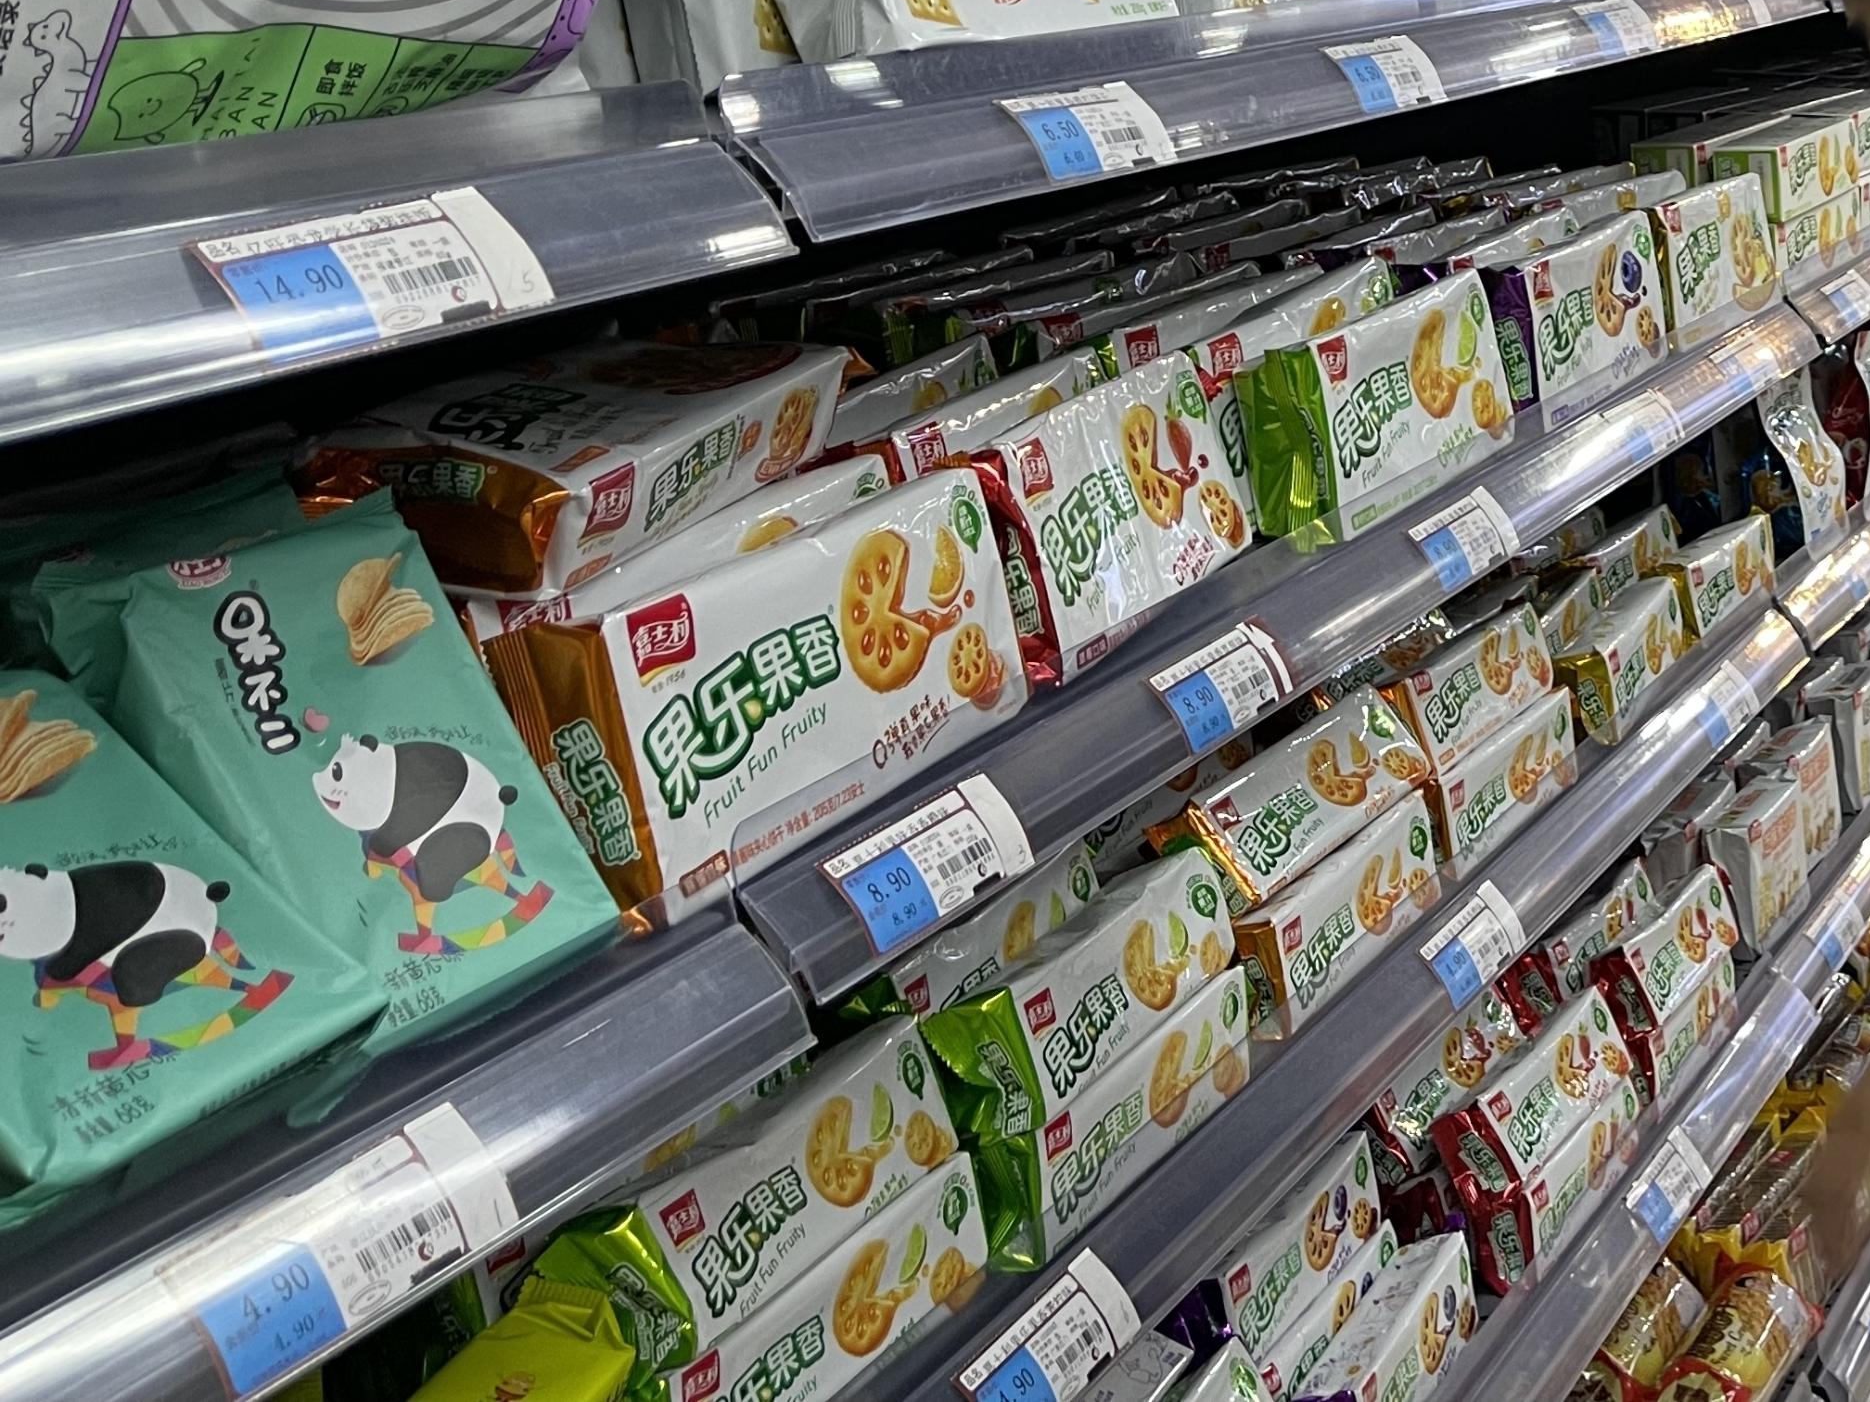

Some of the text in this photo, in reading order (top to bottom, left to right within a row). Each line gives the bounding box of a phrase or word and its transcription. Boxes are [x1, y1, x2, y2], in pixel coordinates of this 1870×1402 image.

[316, 59, 346, 96] 即食
[337, 60, 368, 97] 拌饭
[1042, 119, 1079, 141] 6.50
[254, 263, 345, 305] 14.90
[1539, 286, 1596, 381] 果乐果香
[1331, 361, 1412, 479] 果乐果香
[645, 419, 738, 533] 果乐果香
[1039, 465, 1140, 608] 果乐果香
[630, 610, 692, 664] 嘉士利
[644, 613, 842, 820] 果乐果香
[1182, 687, 1213, 715] 8.90
[1424, 660, 1481, 743] 果乐果香
[550, 718, 642, 868] 果乐果香
[703, 702, 827, 829] Fruit Fun Fruity
[1236, 782, 1319, 876] 果乐果香
[1454, 773, 1507, 857] 果乐果香
[867, 867, 912, 904] 8.90
[892, 902, 918, 927] 8.90
[383, 949, 466, 993] 新黄瓜味
[1289, 902, 1355, 1010] 果乐果香
[1043, 974, 1130, 1098] 果乐果香
[1050, 1091, 1145, 1225] 果乐果香
[1507, 1075, 1557, 1165] 果乐果香
[1098, 1166, 1115, 1191] Fun
[1113, 1141, 1138, 1175] Fruity
[694, 1165, 807, 1318] 果乐果香
[739, 1222, 807, 1319] Fruit Fun Fruity
[241, 1262, 310, 1322] 4.90
[272, 1315, 315, 1352] 4.90
[1239, 1242, 1303, 1352] 果乐果香
[712, 1314, 826, 1401] 乐果香
